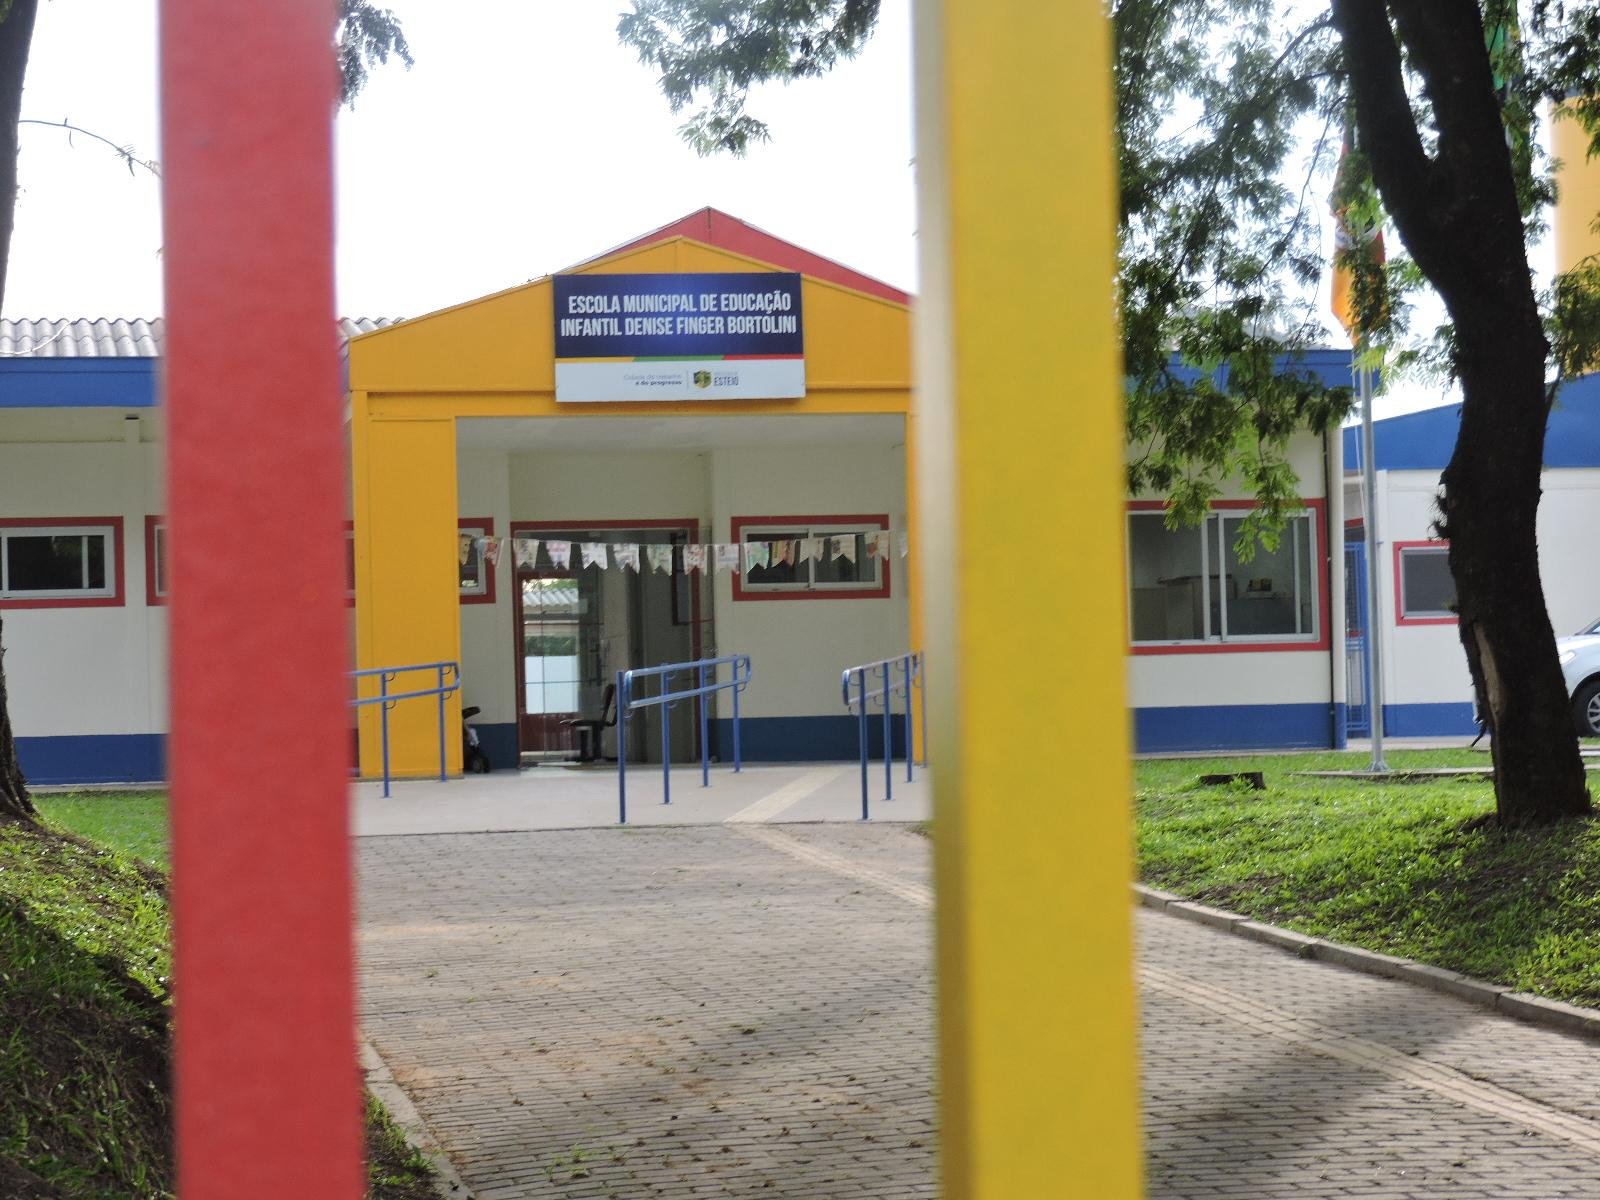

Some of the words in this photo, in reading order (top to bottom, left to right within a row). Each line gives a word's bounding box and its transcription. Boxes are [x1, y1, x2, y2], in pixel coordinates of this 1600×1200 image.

[568, 295, 621, 314] ESCOLA
[623, 294, 697, 314] MUNICIPAL
[700, 293, 719, 312] DE
[721, 291, 792, 314] EDUCAÇÃO
[560, 318, 622, 337] INFANTIL
[625, 317, 673, 336] DENISE
[676, 316, 725, 335] FINGER
[727, 315, 797, 334] BORTOLINI
[714, 376, 739, 386] ESTEIO
